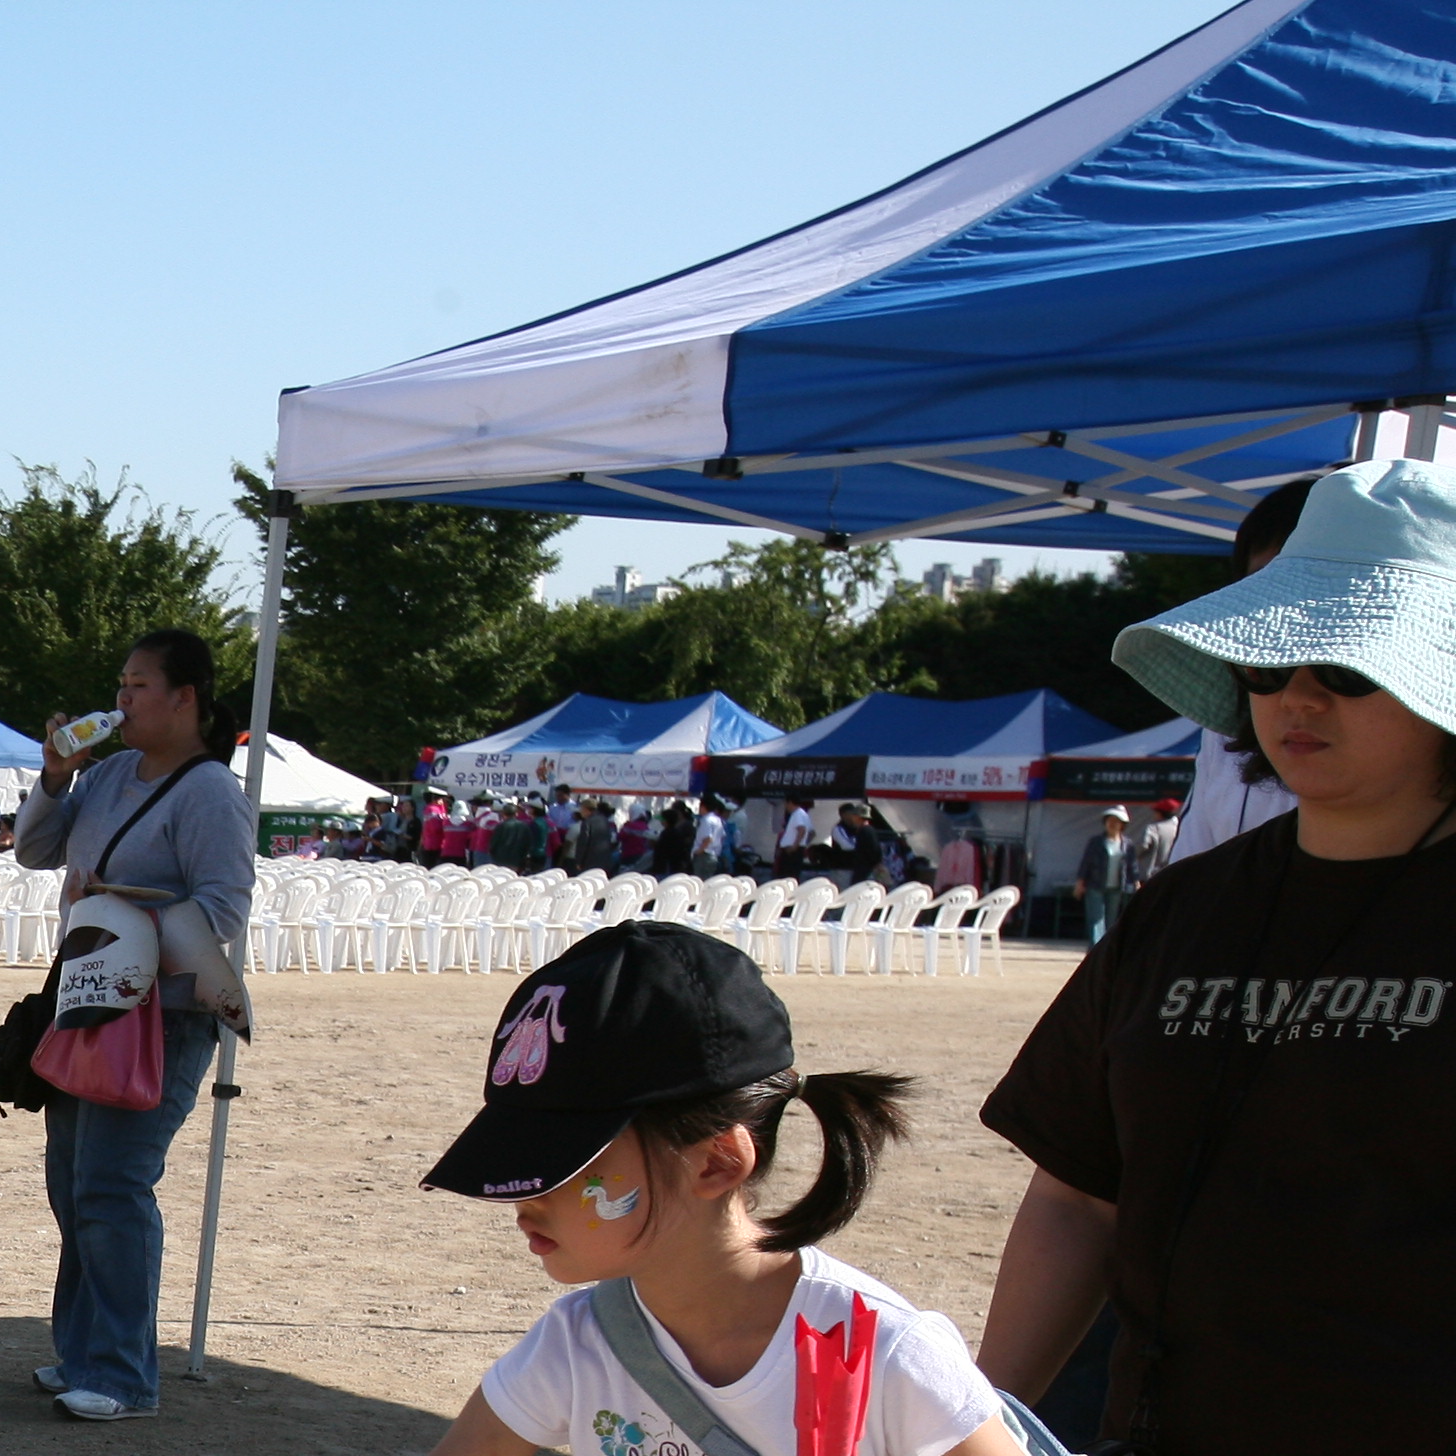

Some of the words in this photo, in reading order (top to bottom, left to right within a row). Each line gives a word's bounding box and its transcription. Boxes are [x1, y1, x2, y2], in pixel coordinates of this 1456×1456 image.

[475, 754, 513, 768] 광진구
[455, 772, 528, 787] 우수기업제품
[81, 960, 105, 972] 2007
[85, 993, 106, 1004] 축제
[1158, 976, 1446, 1028] STANFORD
[1163, 1021, 1411, 1045] UNVERSITY
[483, 1177, 543, 1194] ballet
